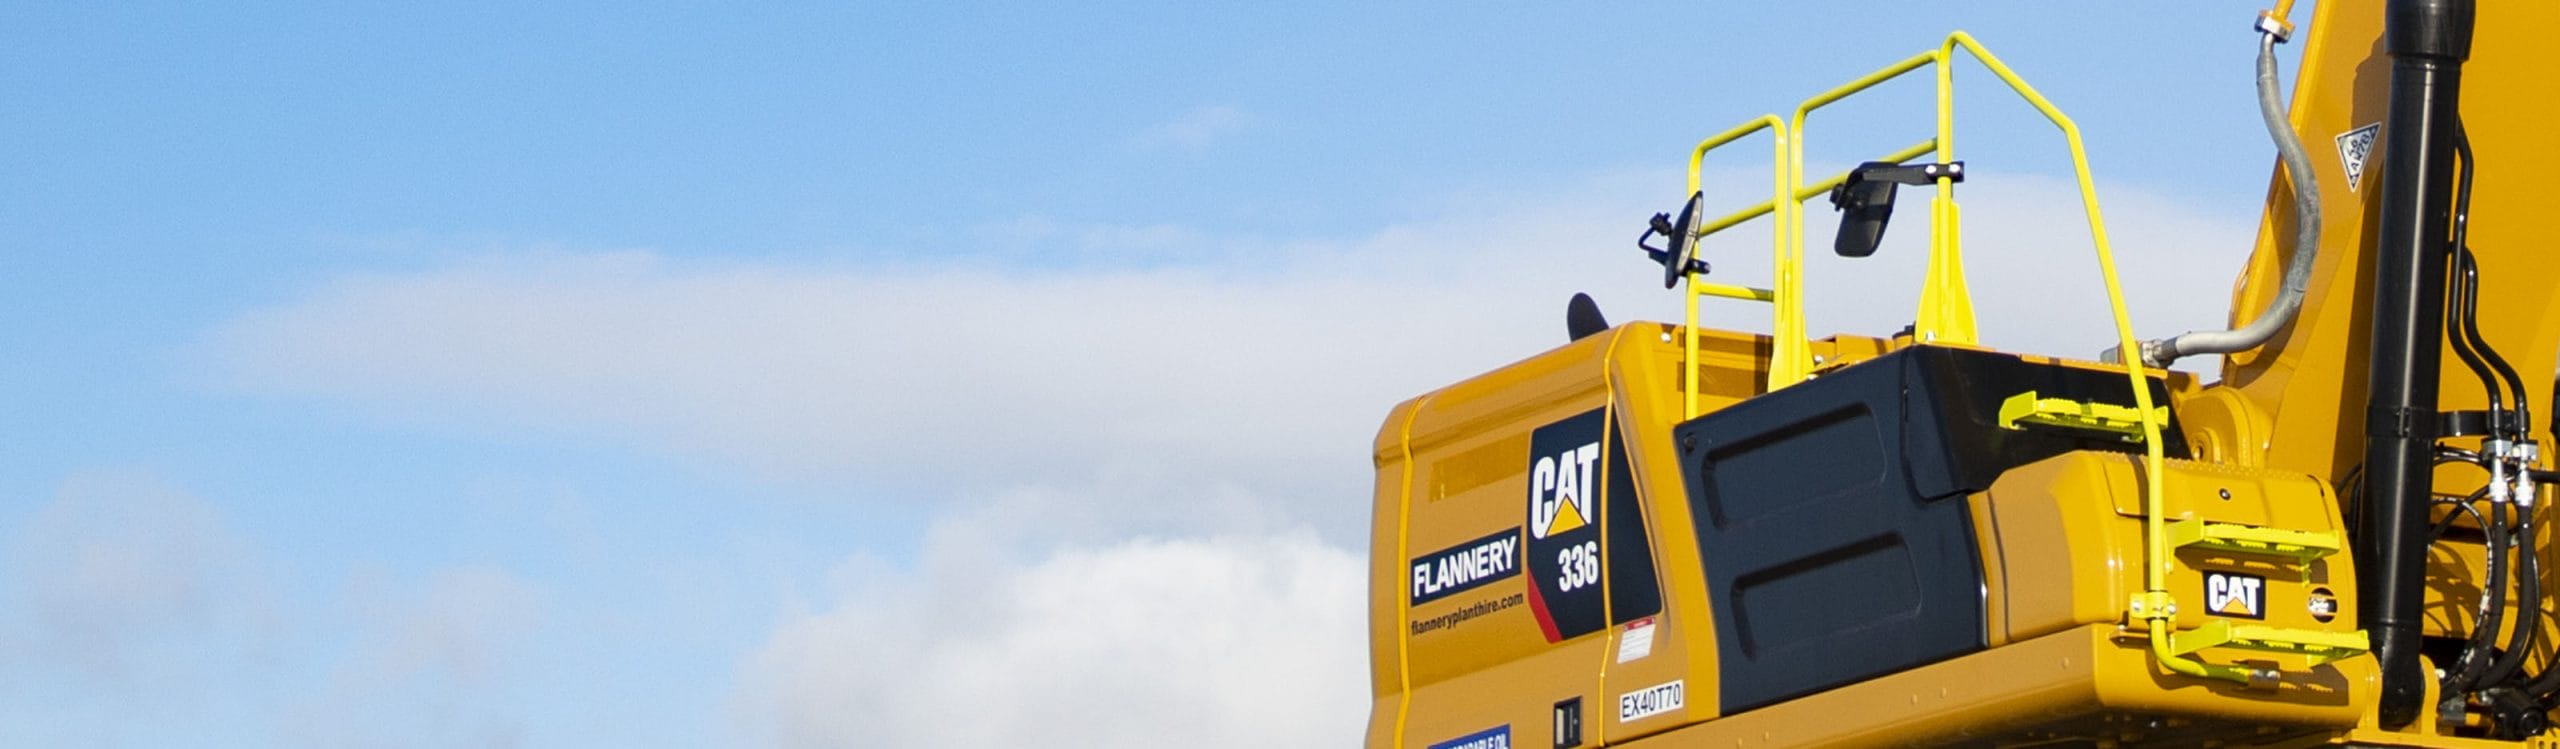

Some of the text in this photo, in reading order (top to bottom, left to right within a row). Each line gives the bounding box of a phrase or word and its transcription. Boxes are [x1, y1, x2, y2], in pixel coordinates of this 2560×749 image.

[1532, 442, 1599, 539] CAT
[1413, 536, 1517, 598] FLANNERY
[1558, 541, 1598, 592] 336
[1411, 593, 1524, 636] flanneryplanthire.com
[2207, 574, 2260, 616] CAT
[1622, 683, 1680, 718] EX40T70
